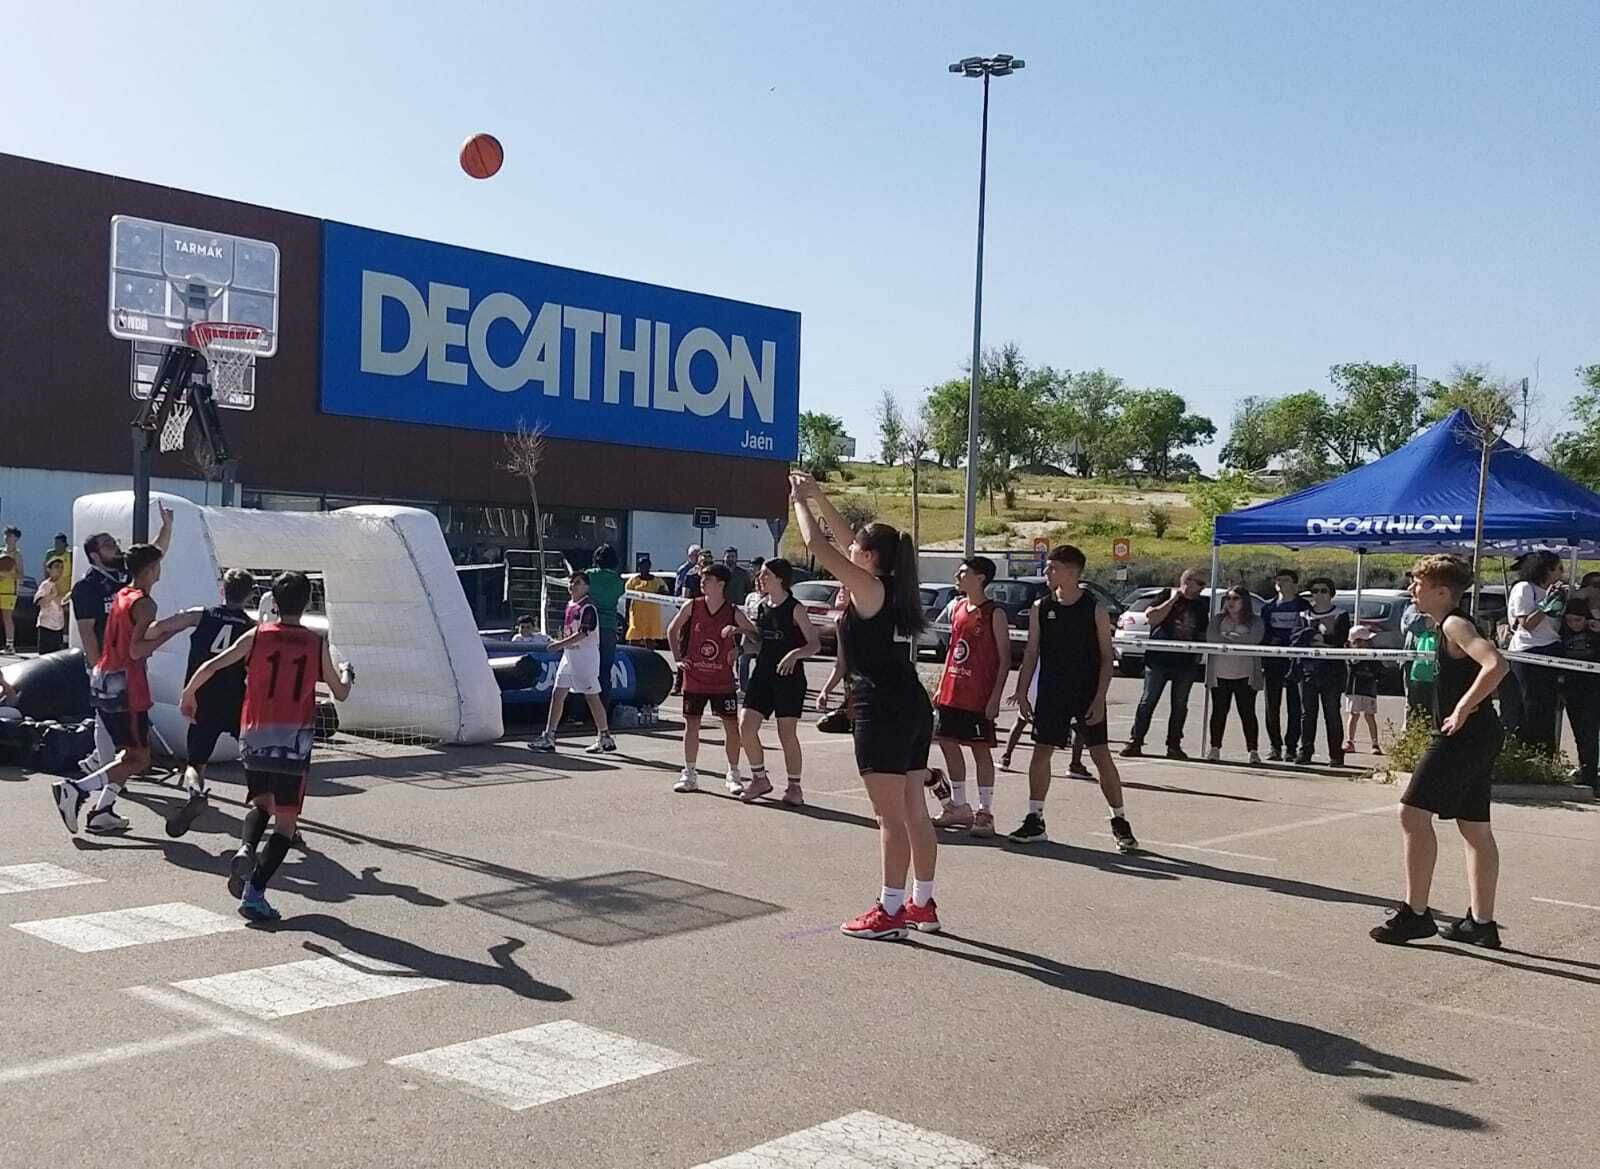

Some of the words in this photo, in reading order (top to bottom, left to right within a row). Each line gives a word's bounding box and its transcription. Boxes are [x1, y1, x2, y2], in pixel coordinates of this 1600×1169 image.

[174, 240, 223, 259] TARMAK
[361, 269, 776, 424] DECATHLON
[740, 430, 774, 451] Jaén
[1306, 514, 1464, 536] DECATHLON
[210, 624, 233, 654] 4
[266, 650, 308, 703] 11
[724, 699, 736, 711] 33
